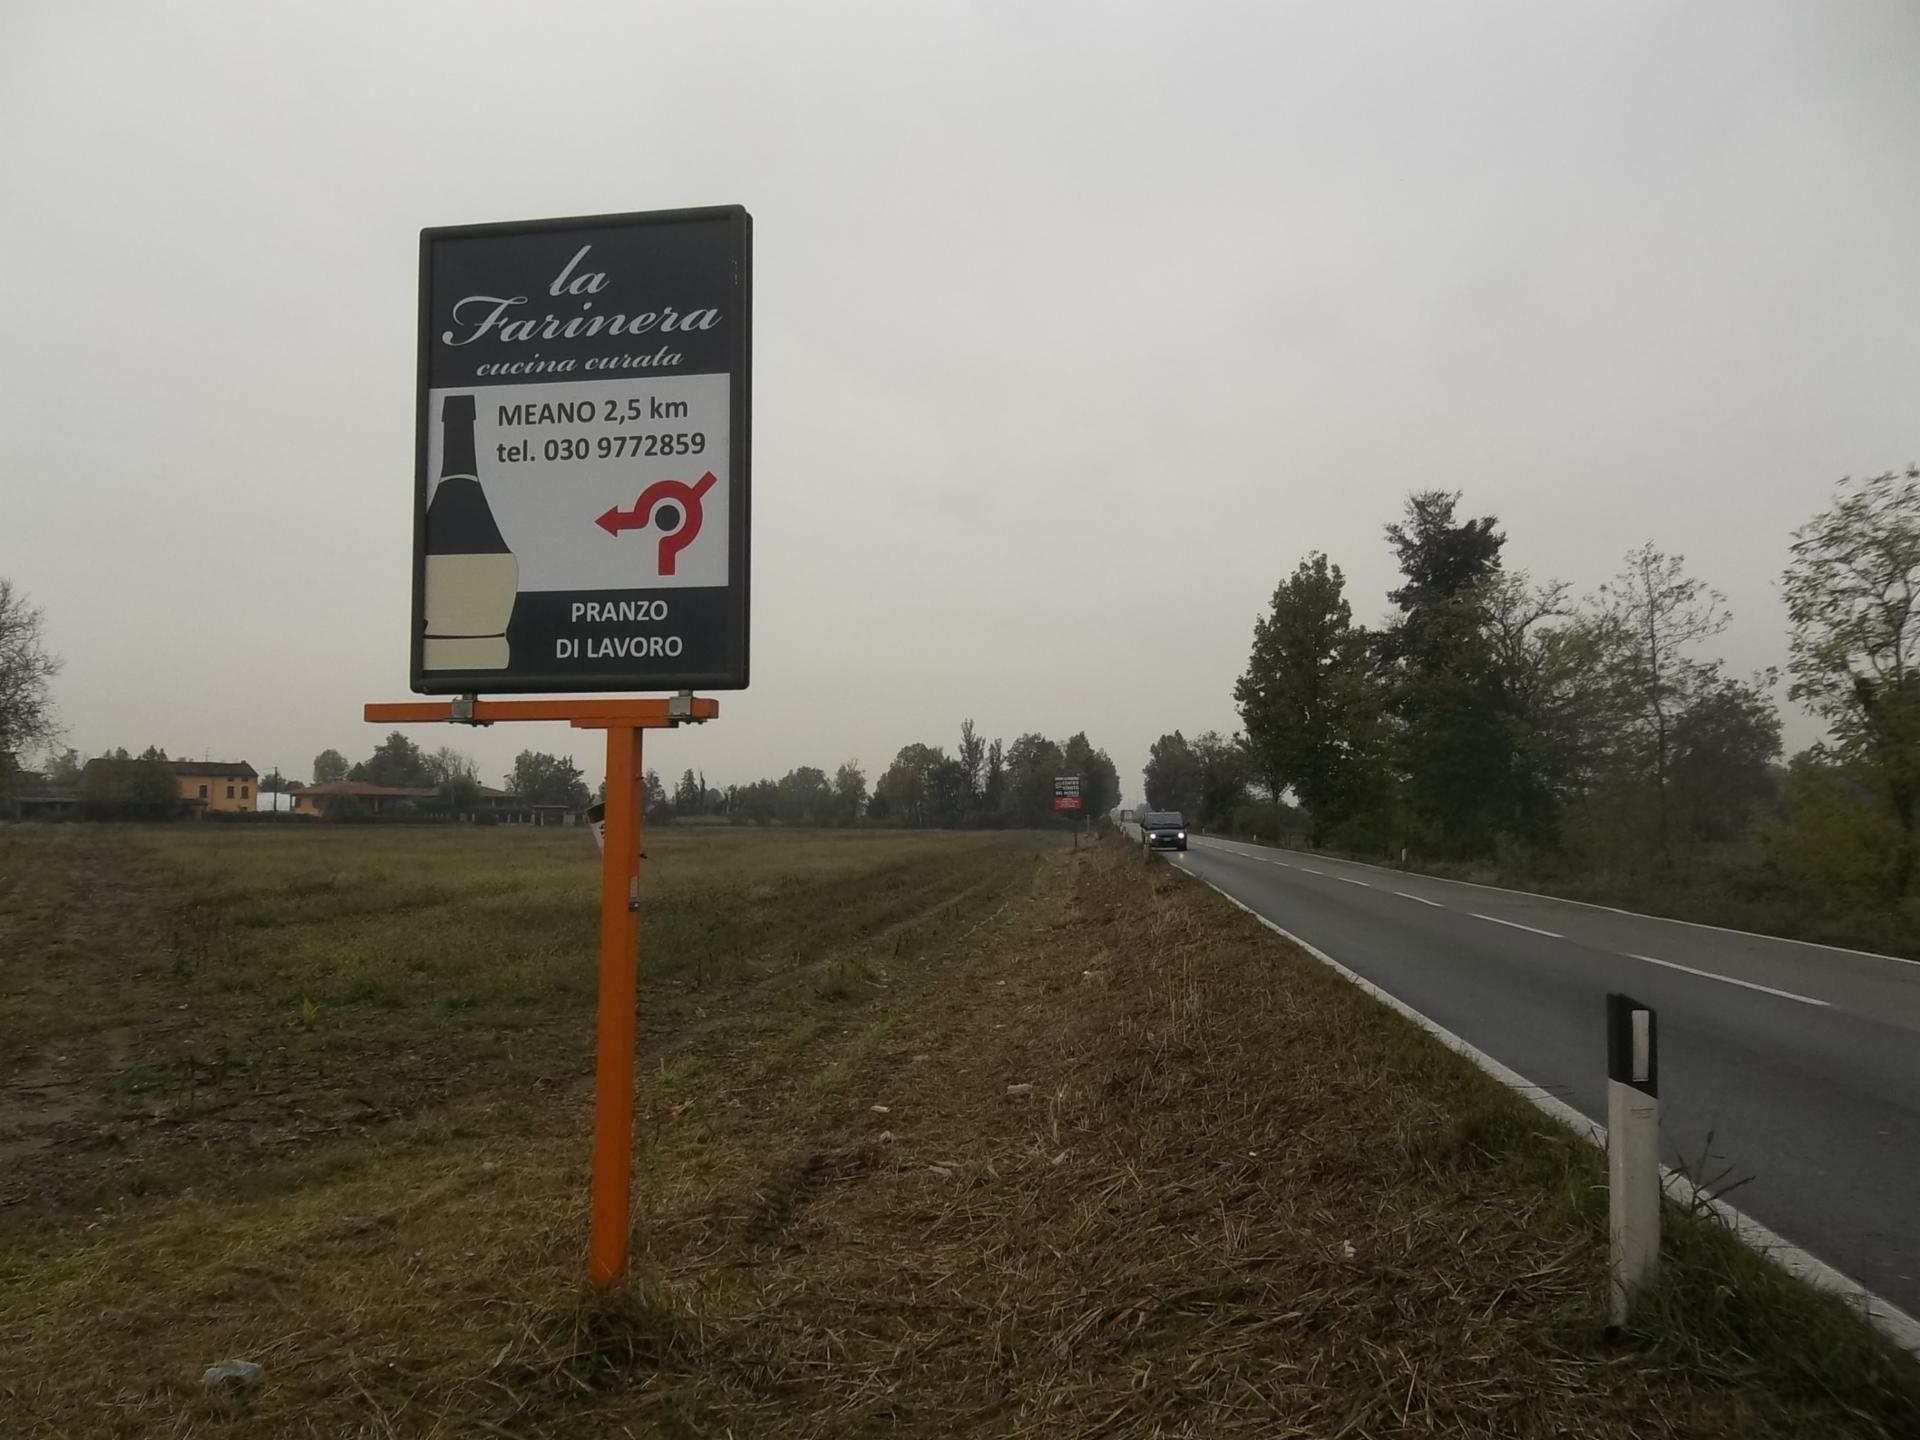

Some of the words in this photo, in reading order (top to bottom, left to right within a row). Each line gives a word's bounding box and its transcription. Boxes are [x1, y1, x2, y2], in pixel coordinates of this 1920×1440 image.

[549, 245, 610, 296] la
[442, 296, 722, 346] Farinera
[476, 353, 577, 377] cucina
[584, 345, 683, 371] curata
[498, 401, 596, 426] MEANO
[603, 398, 641, 425] 2,5
[650, 396, 688, 419] km
[497, 440, 535, 463] tel.
[544, 438, 590, 461] 030
[597, 432, 705, 459] 9772859
[571, 600, 668, 623] PRANZO
[556, 638, 578, 659] DI
[587, 636, 682, 658] LAVORO
